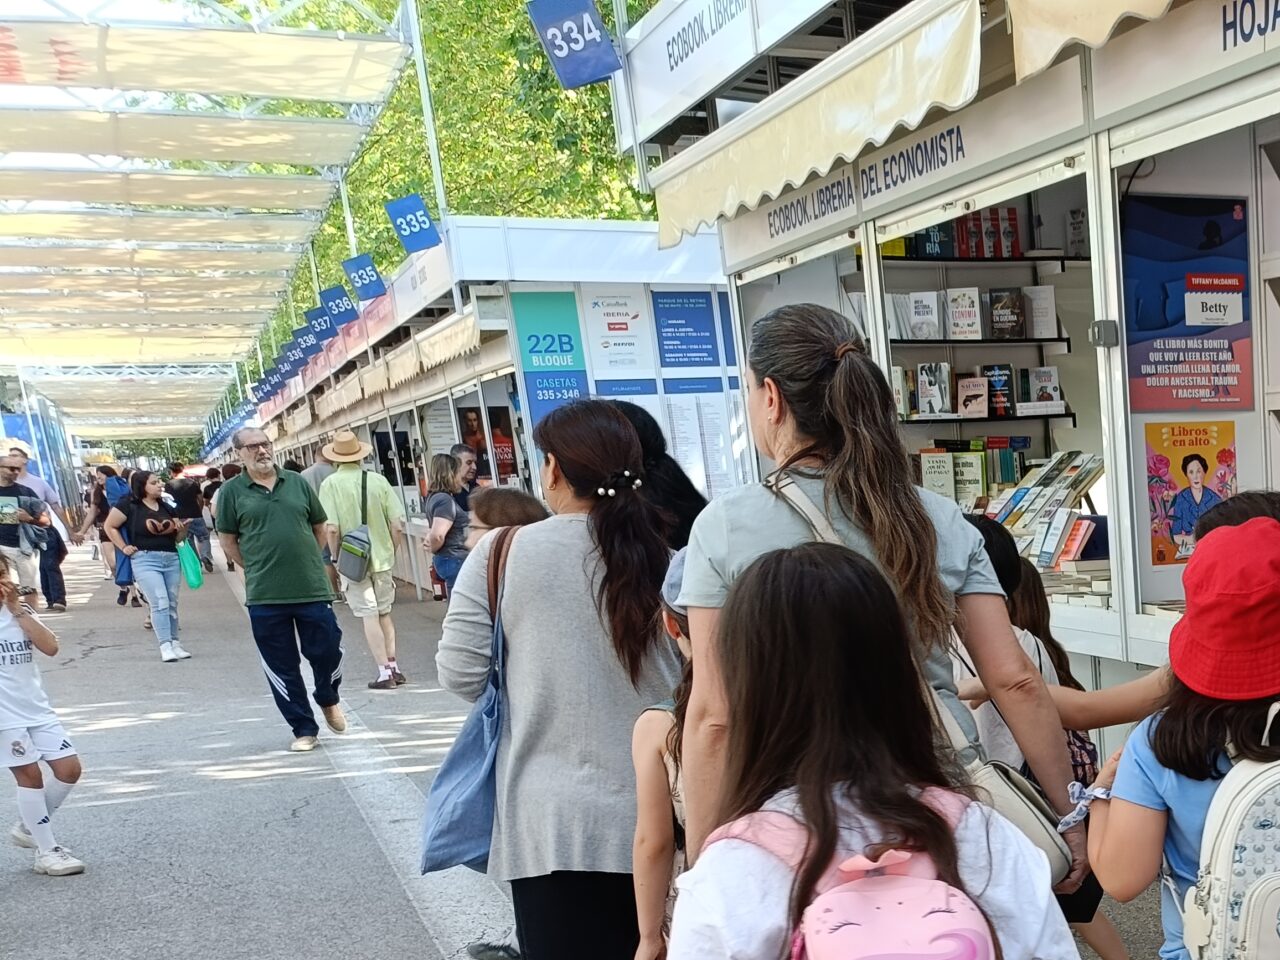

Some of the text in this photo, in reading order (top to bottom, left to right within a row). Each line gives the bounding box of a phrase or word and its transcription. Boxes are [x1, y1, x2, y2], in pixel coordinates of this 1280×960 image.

[547, 12, 601, 58] 334
[666, 13, 709, 72] ECOBOOK.
[768, 125, 966, 239] ECOBOOK. LIBRERÍA DEL ECONOMISTA
[396, 210, 431, 236] 335
[350, 265, 378, 288] 335
[1191, 277, 1240, 286] TIFFANY McDANIEL
[328, 296, 352, 315] 336
[1200, 301, 1228, 316] Betty
[311, 316, 330, 332] 337
[297, 334, 317, 349] 338
[527, 334, 574, 354] 22B
[1165, 339, 1186, 349] LIBRO
[1187, 338, 1203, 349] MÁS
[1203, 339, 1229, 349] BONITO
[532, 355, 574, 367] BLOQUE
[1149, 351, 1234, 362] QUE VOY A LEER ESTE AÑO.
[1141, 364, 1156, 374] UNA
[1157, 364, 1190, 374] HISTORIA
[1190, 364, 1211, 374] LLENA
[1211, 364, 1220, 374] DE
[261, 383, 271, 392] 34
[536, 378, 577, 388] CASETAS
[1146, 377, 1169, 387] DOLOR
[1210, 376, 1238, 386] TRAUMA
[1172, 388, 1178, 398] Y
[1171, 426, 1208, 437] Libros
[1172, 437, 1210, 447] en alto
